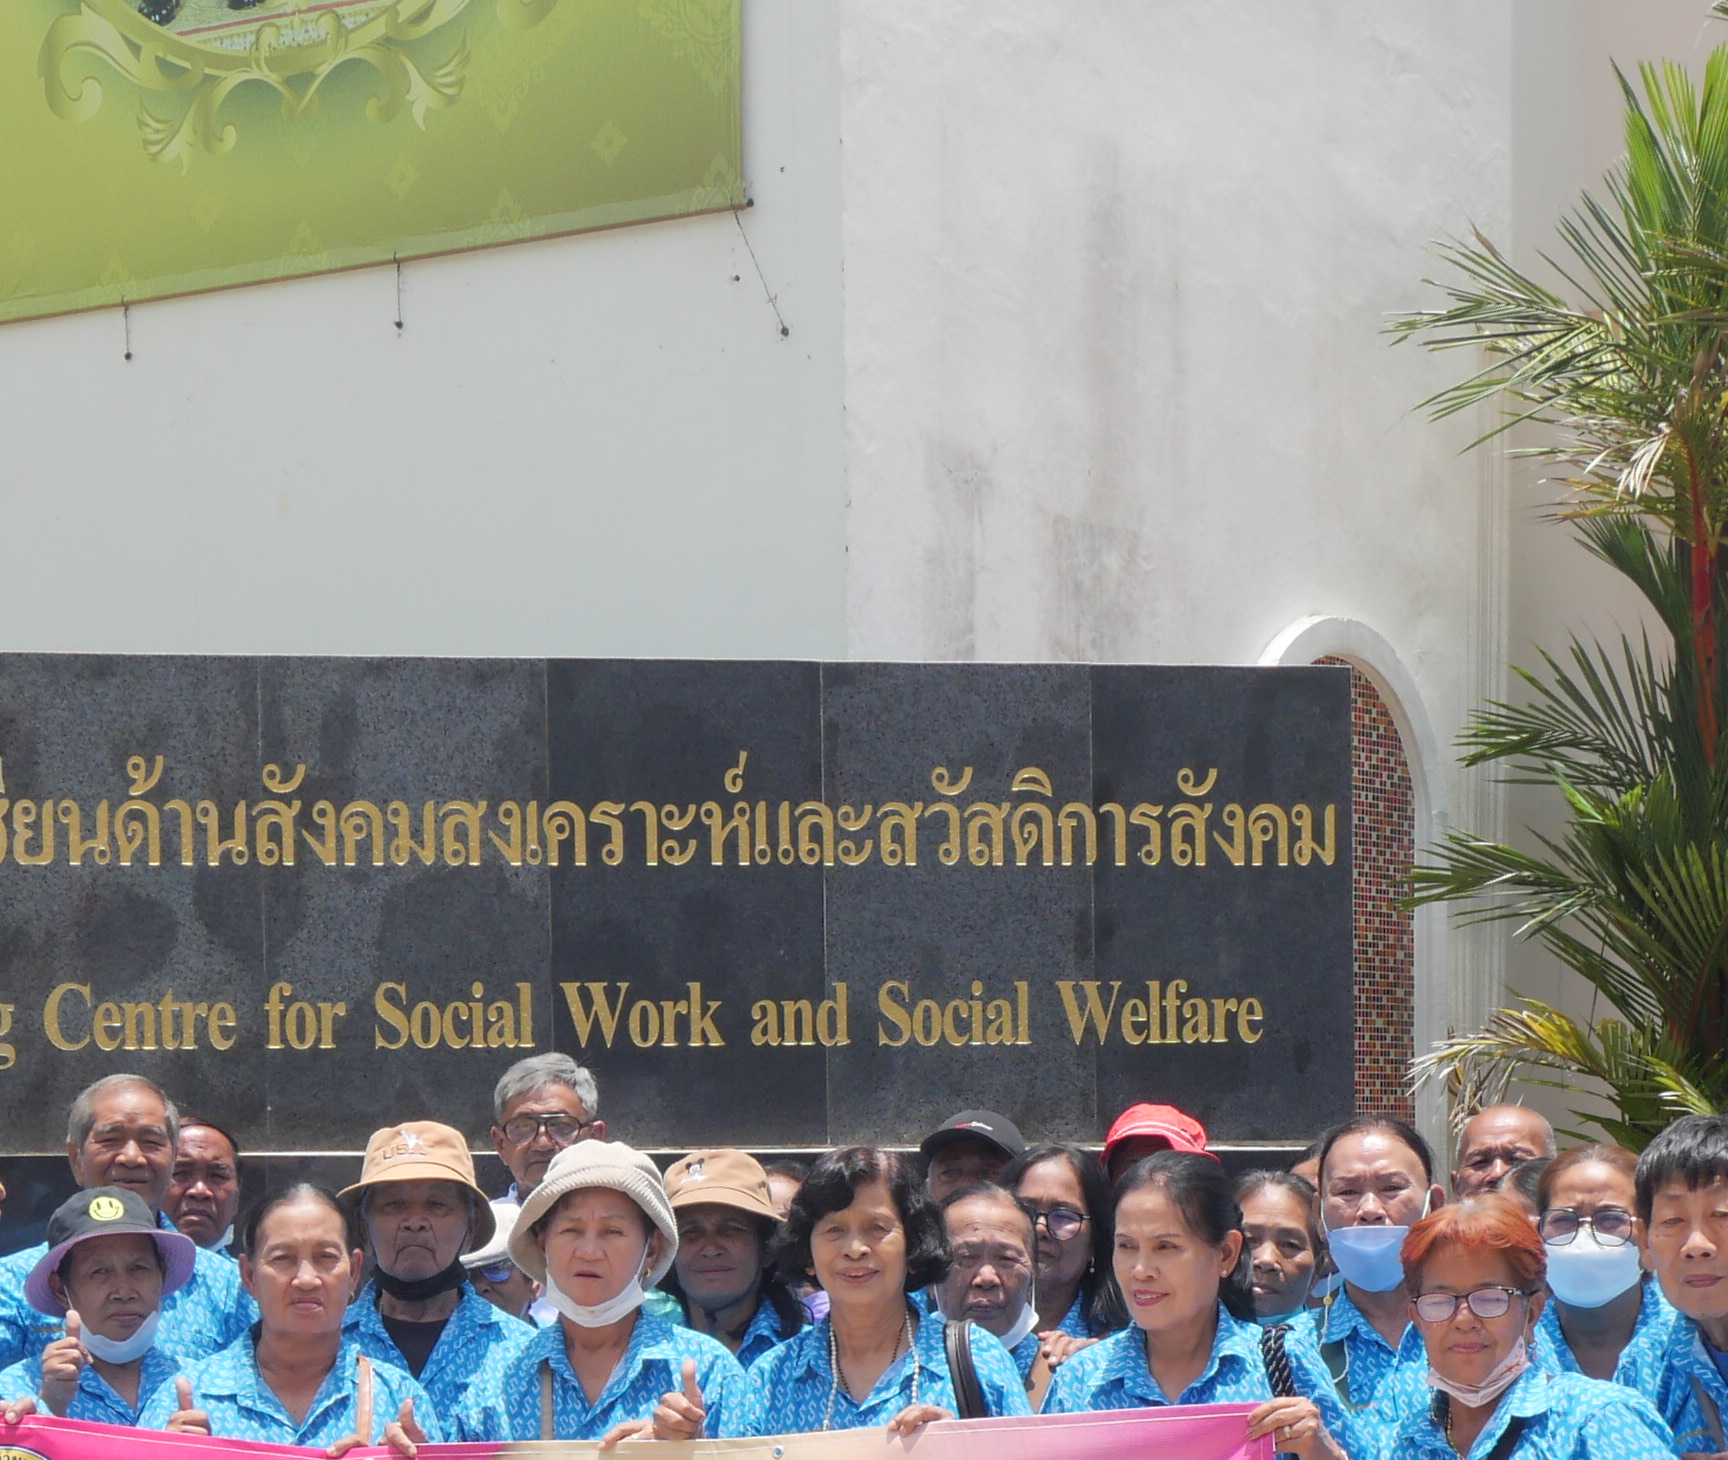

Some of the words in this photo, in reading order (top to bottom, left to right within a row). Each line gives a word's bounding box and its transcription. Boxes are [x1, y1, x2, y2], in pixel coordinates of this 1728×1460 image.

[44, 983, 238, 1050] Centre
[265, 983, 348, 1049] for
[375, 981, 535, 1049] Social
[560, 981, 726, 1048] Work
[751, 982, 850, 1047] and
[878, 980, 1032, 1046] Social
[1057, 979, 1265, 1045] Welfare
